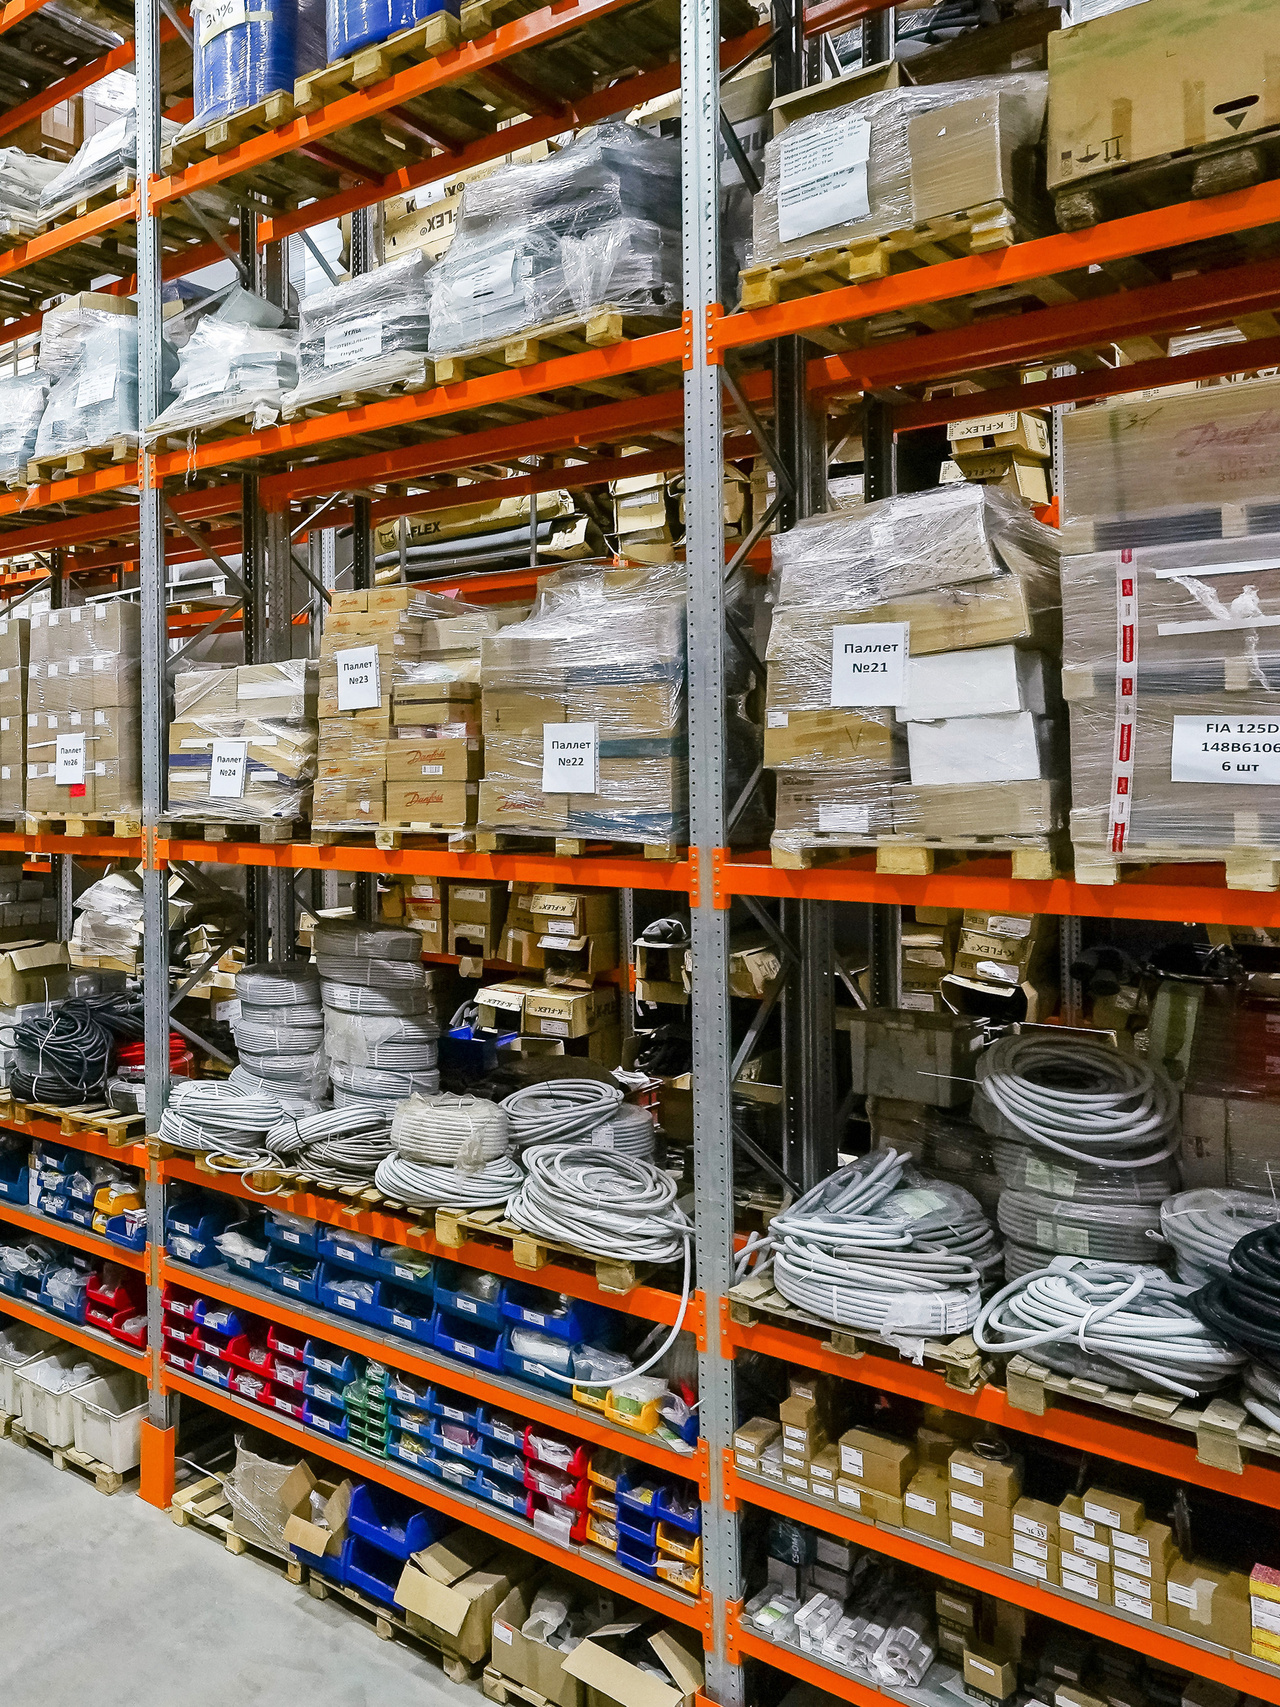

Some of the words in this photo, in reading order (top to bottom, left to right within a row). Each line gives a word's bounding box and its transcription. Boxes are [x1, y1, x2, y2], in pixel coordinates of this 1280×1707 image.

[399, 520, 441, 541] -FLEX
[844, 643, 899, 653] Паллет
[343, 661, 373, 671] Паллет
[852, 662, 888, 673] №21
[349, 675, 369, 685] №23
[1206, 723, 1231, 733] FIA
[1237, 723, 1279, 733] 125D
[552, 740, 591, 750] Паллет
[1201, 742, 1280, 753] 148B6106
[216, 755, 242, 763] Паллет
[406, 748, 446, 765] Danfoss
[558, 757, 584, 766] №22
[1221, 761, 1231, 771] 6
[219, 769, 236, 777] №24
[404, 790, 444, 807] Danfoss
